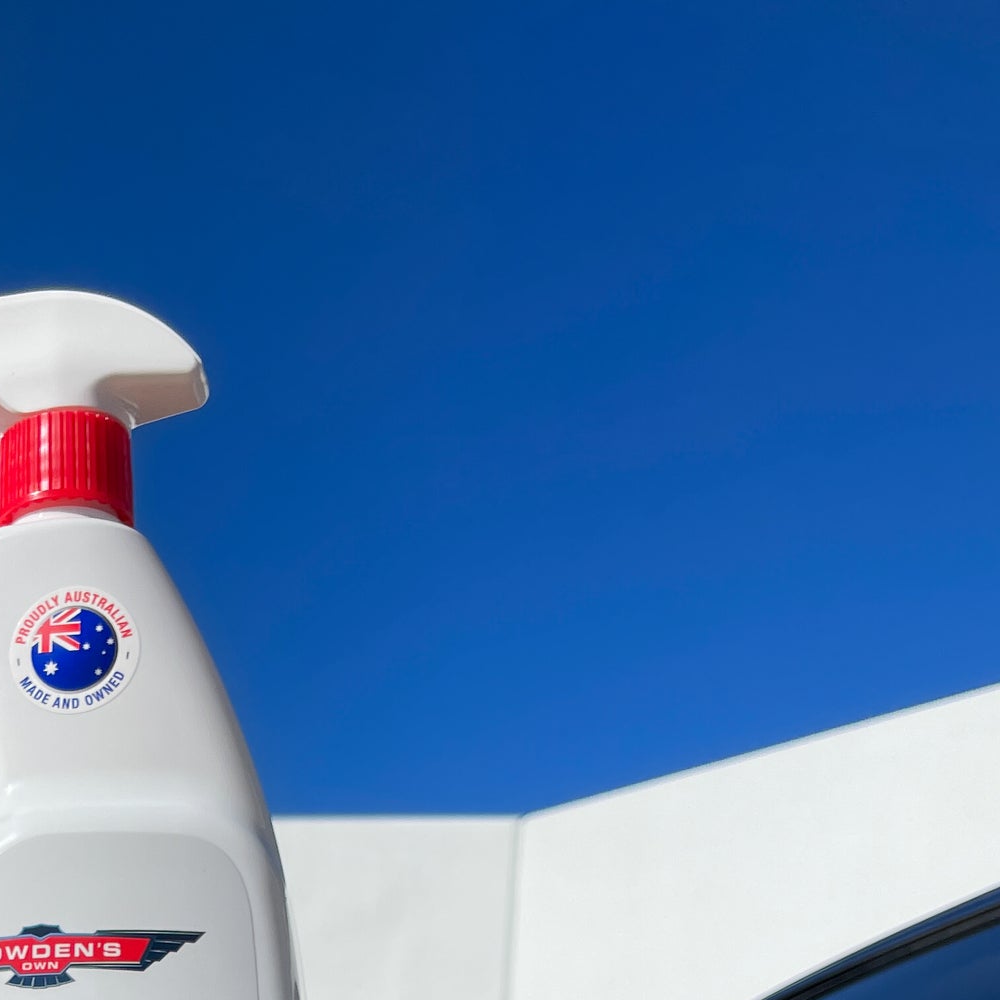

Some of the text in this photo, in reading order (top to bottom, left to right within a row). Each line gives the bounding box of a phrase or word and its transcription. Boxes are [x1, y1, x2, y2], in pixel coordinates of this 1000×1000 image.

[15, 591, 133, 645] PROUDLY AUSTRALIAN
[20, 671, 125, 709] MADE AND OWNED
[22, 961, 59, 971] OWN
